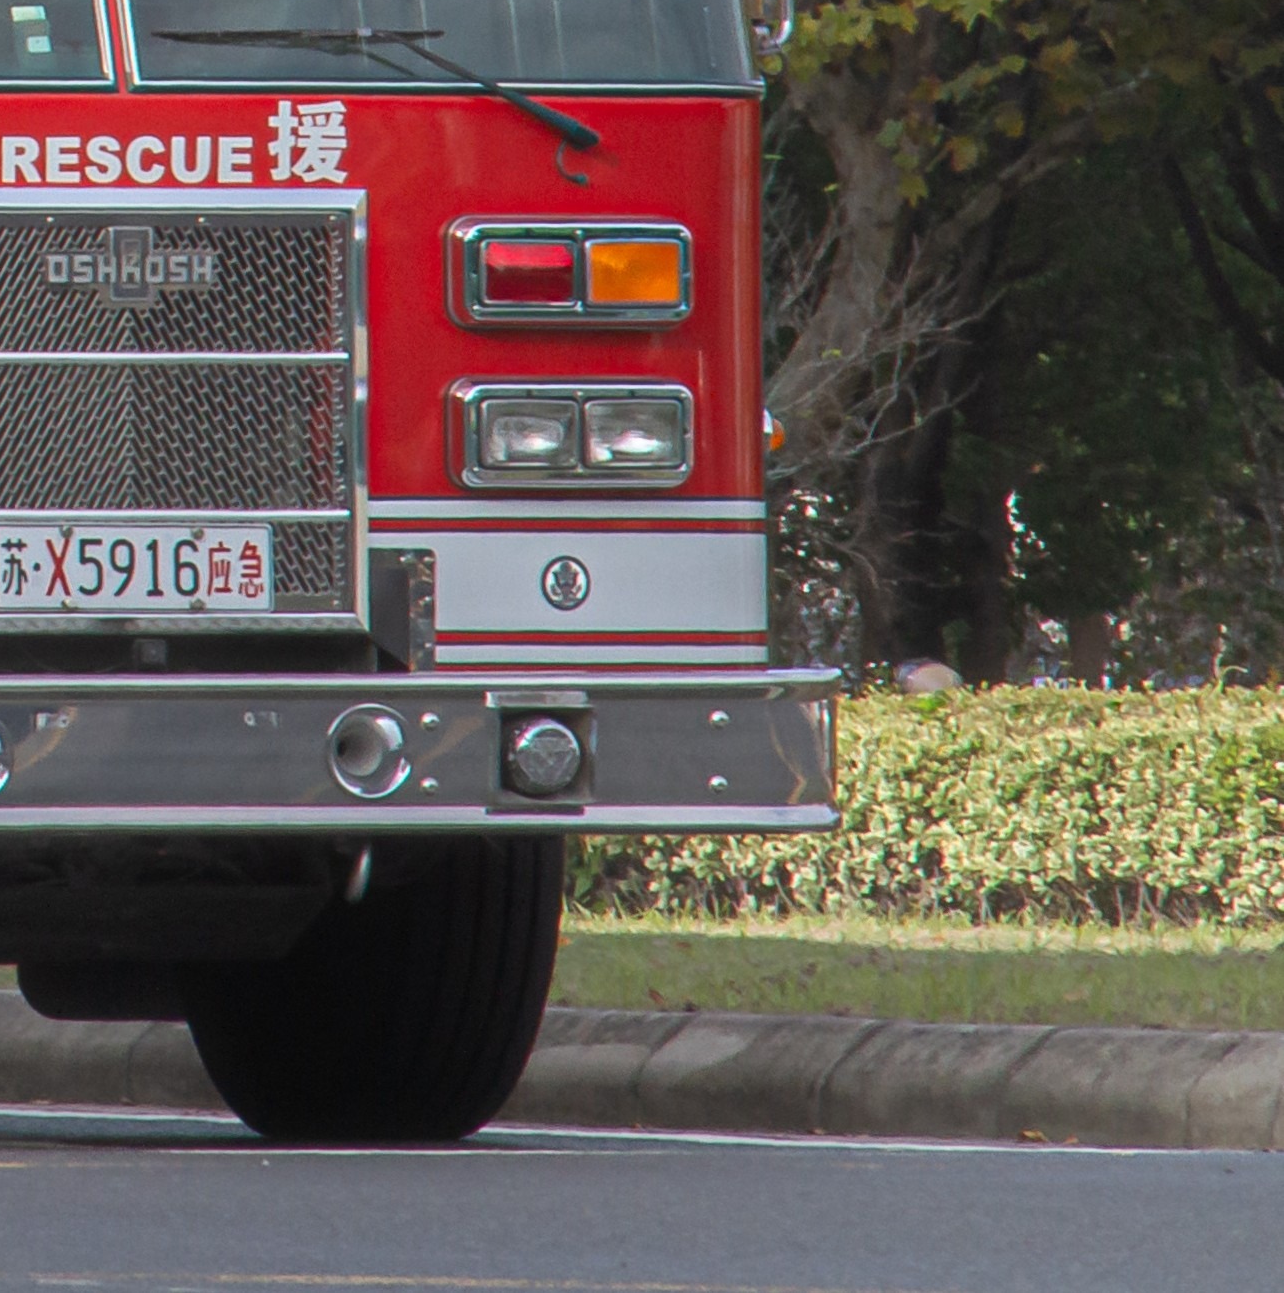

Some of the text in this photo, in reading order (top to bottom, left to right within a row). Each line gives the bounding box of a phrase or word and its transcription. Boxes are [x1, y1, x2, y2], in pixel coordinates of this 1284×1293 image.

[1, 136, 253, 183] RESCUE
[268, 101, 348, 183] 援
[47, 255, 212, 283] OSHKOSH
